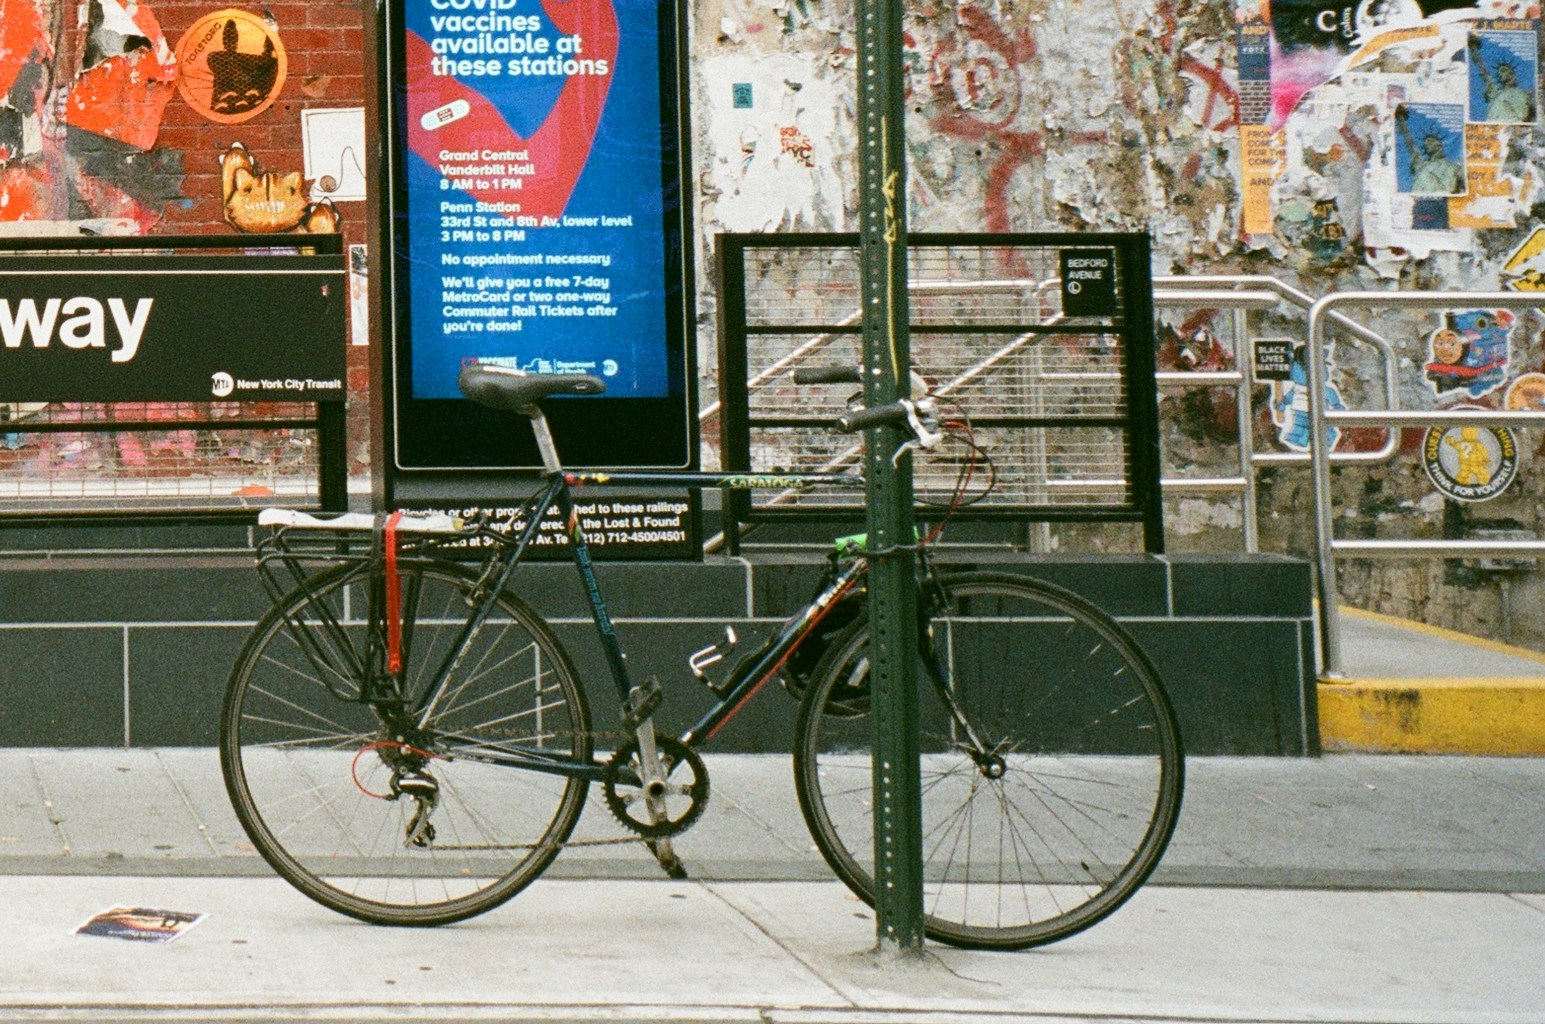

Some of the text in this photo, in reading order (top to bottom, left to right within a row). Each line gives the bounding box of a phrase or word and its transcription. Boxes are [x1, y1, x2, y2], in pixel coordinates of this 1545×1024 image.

[430, 11, 541, 32] vaccines
[1240, 26, 1267, 35] AND
[431, 34, 582, 54] available at
[430, 56, 609, 76] these stations
[439, 150, 529, 161] Grand Central
[439, 164, 535, 175] Vanderbilt Hall
[440, 179, 522, 190] 8 AM to 1 PM
[1249, 177, 1274, 187] AND
[440, 202, 521, 213] Penn Station
[441, 216, 633, 228] 33rd St and 8th Av, lower level
[441, 231, 525, 241] 3 PM to 8 PM
[442, 254, 610, 266] No appointment necessary
[1067, 258, 1108, 268] BEDFORD
[1067, 270, 1103, 280] AVENUE
[442, 276, 609, 290] We'll give you a free 7-day
[442, 291, 610, 304] MetroCard or two one-way
[442, 305, 618, 317] Commuter Rail Tickets after
[443, 320, 522, 333] you're done!
[1258, 346, 1286, 354] BLACK
[1260, 355, 1285, 363] LIVES
[1257, 363, 1291, 371] MATTER
[237, 379, 259, 389] New
[261, 379, 283, 389] York
[285, 379, 304, 391] City
[306, 379, 342, 389] Transit
[1429, 460, 1513, 496] THINK FOR YOURSELF
[448, 509, 460, 517] or
[598, 504, 610, 514] to
[612, 503, 644, 513] these
[646, 502, 688, 514] railings
[583, 518, 601, 529] the
[604, 517, 630, 528] Lost
[632, 517, 641, 527] &
[643, 516, 680, 527] Found
[536, 534, 553, 544] Av.
[581, 533, 605, 545] 212)
[608, 531, 685, 543] 712-4500/4501
